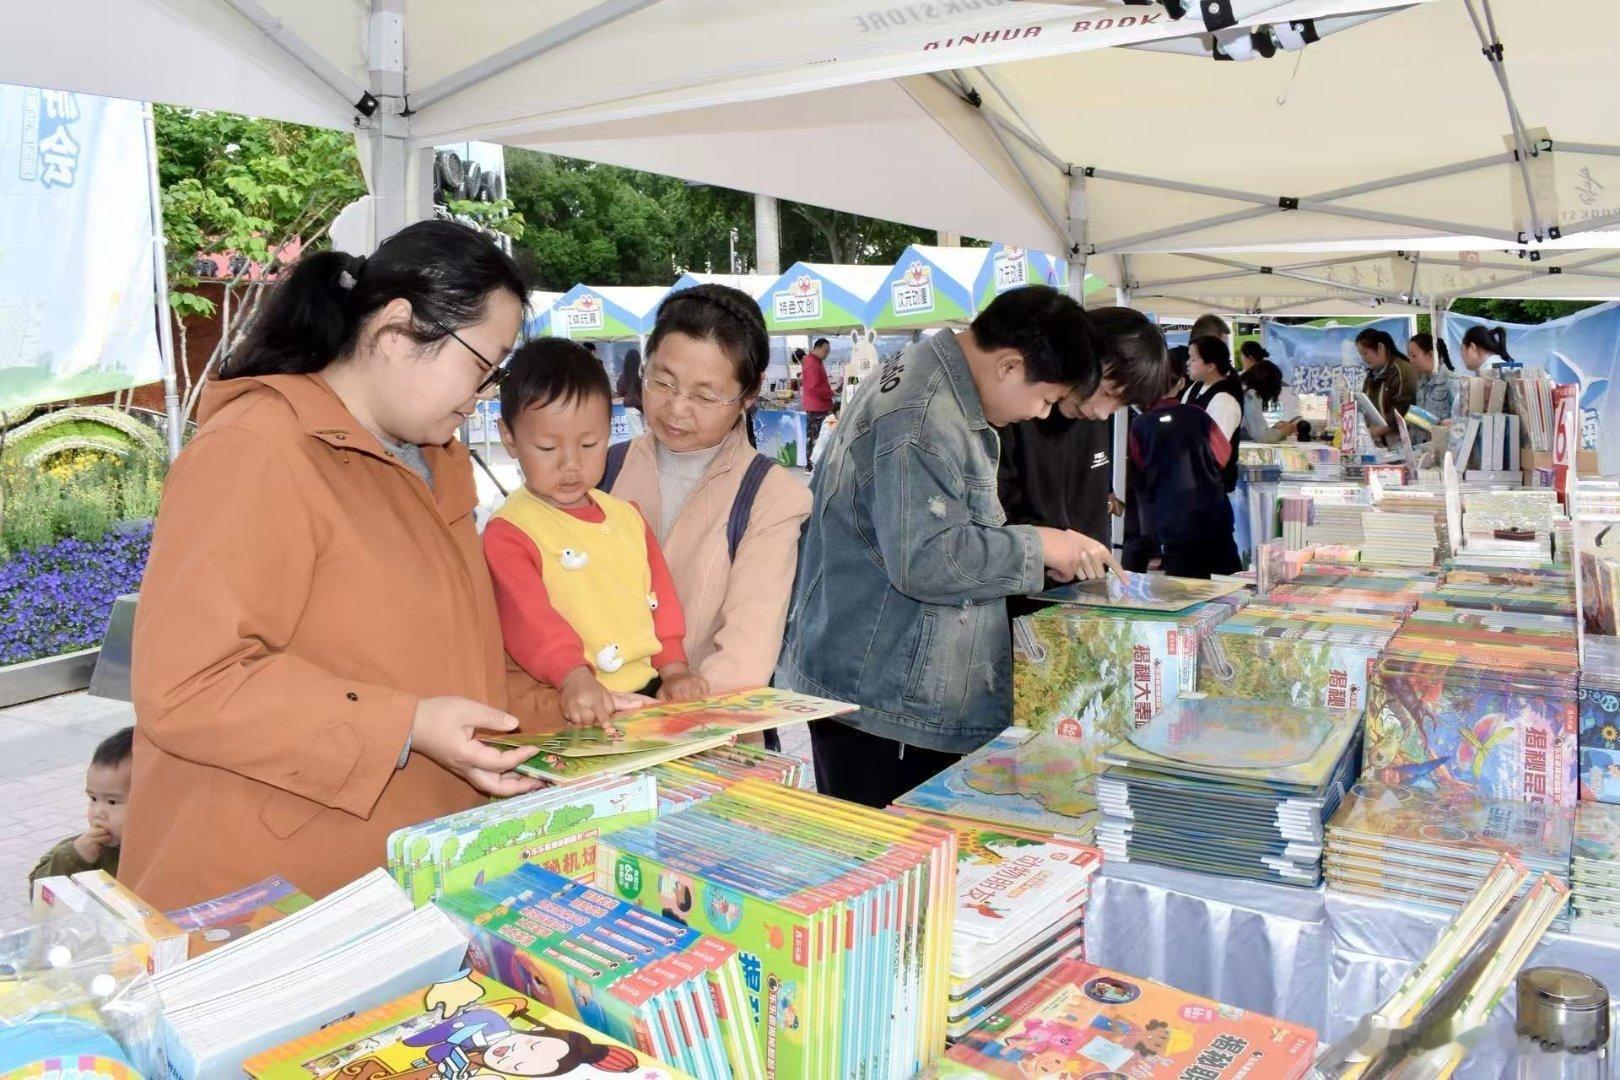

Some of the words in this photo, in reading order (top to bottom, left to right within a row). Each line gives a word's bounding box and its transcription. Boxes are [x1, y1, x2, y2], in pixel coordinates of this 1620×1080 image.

[1071, 12, 1184, 33] BOOK
[779, 299, 815, 316] 特色文创
[1134, 644, 1152, 729] 揭秘大秦
